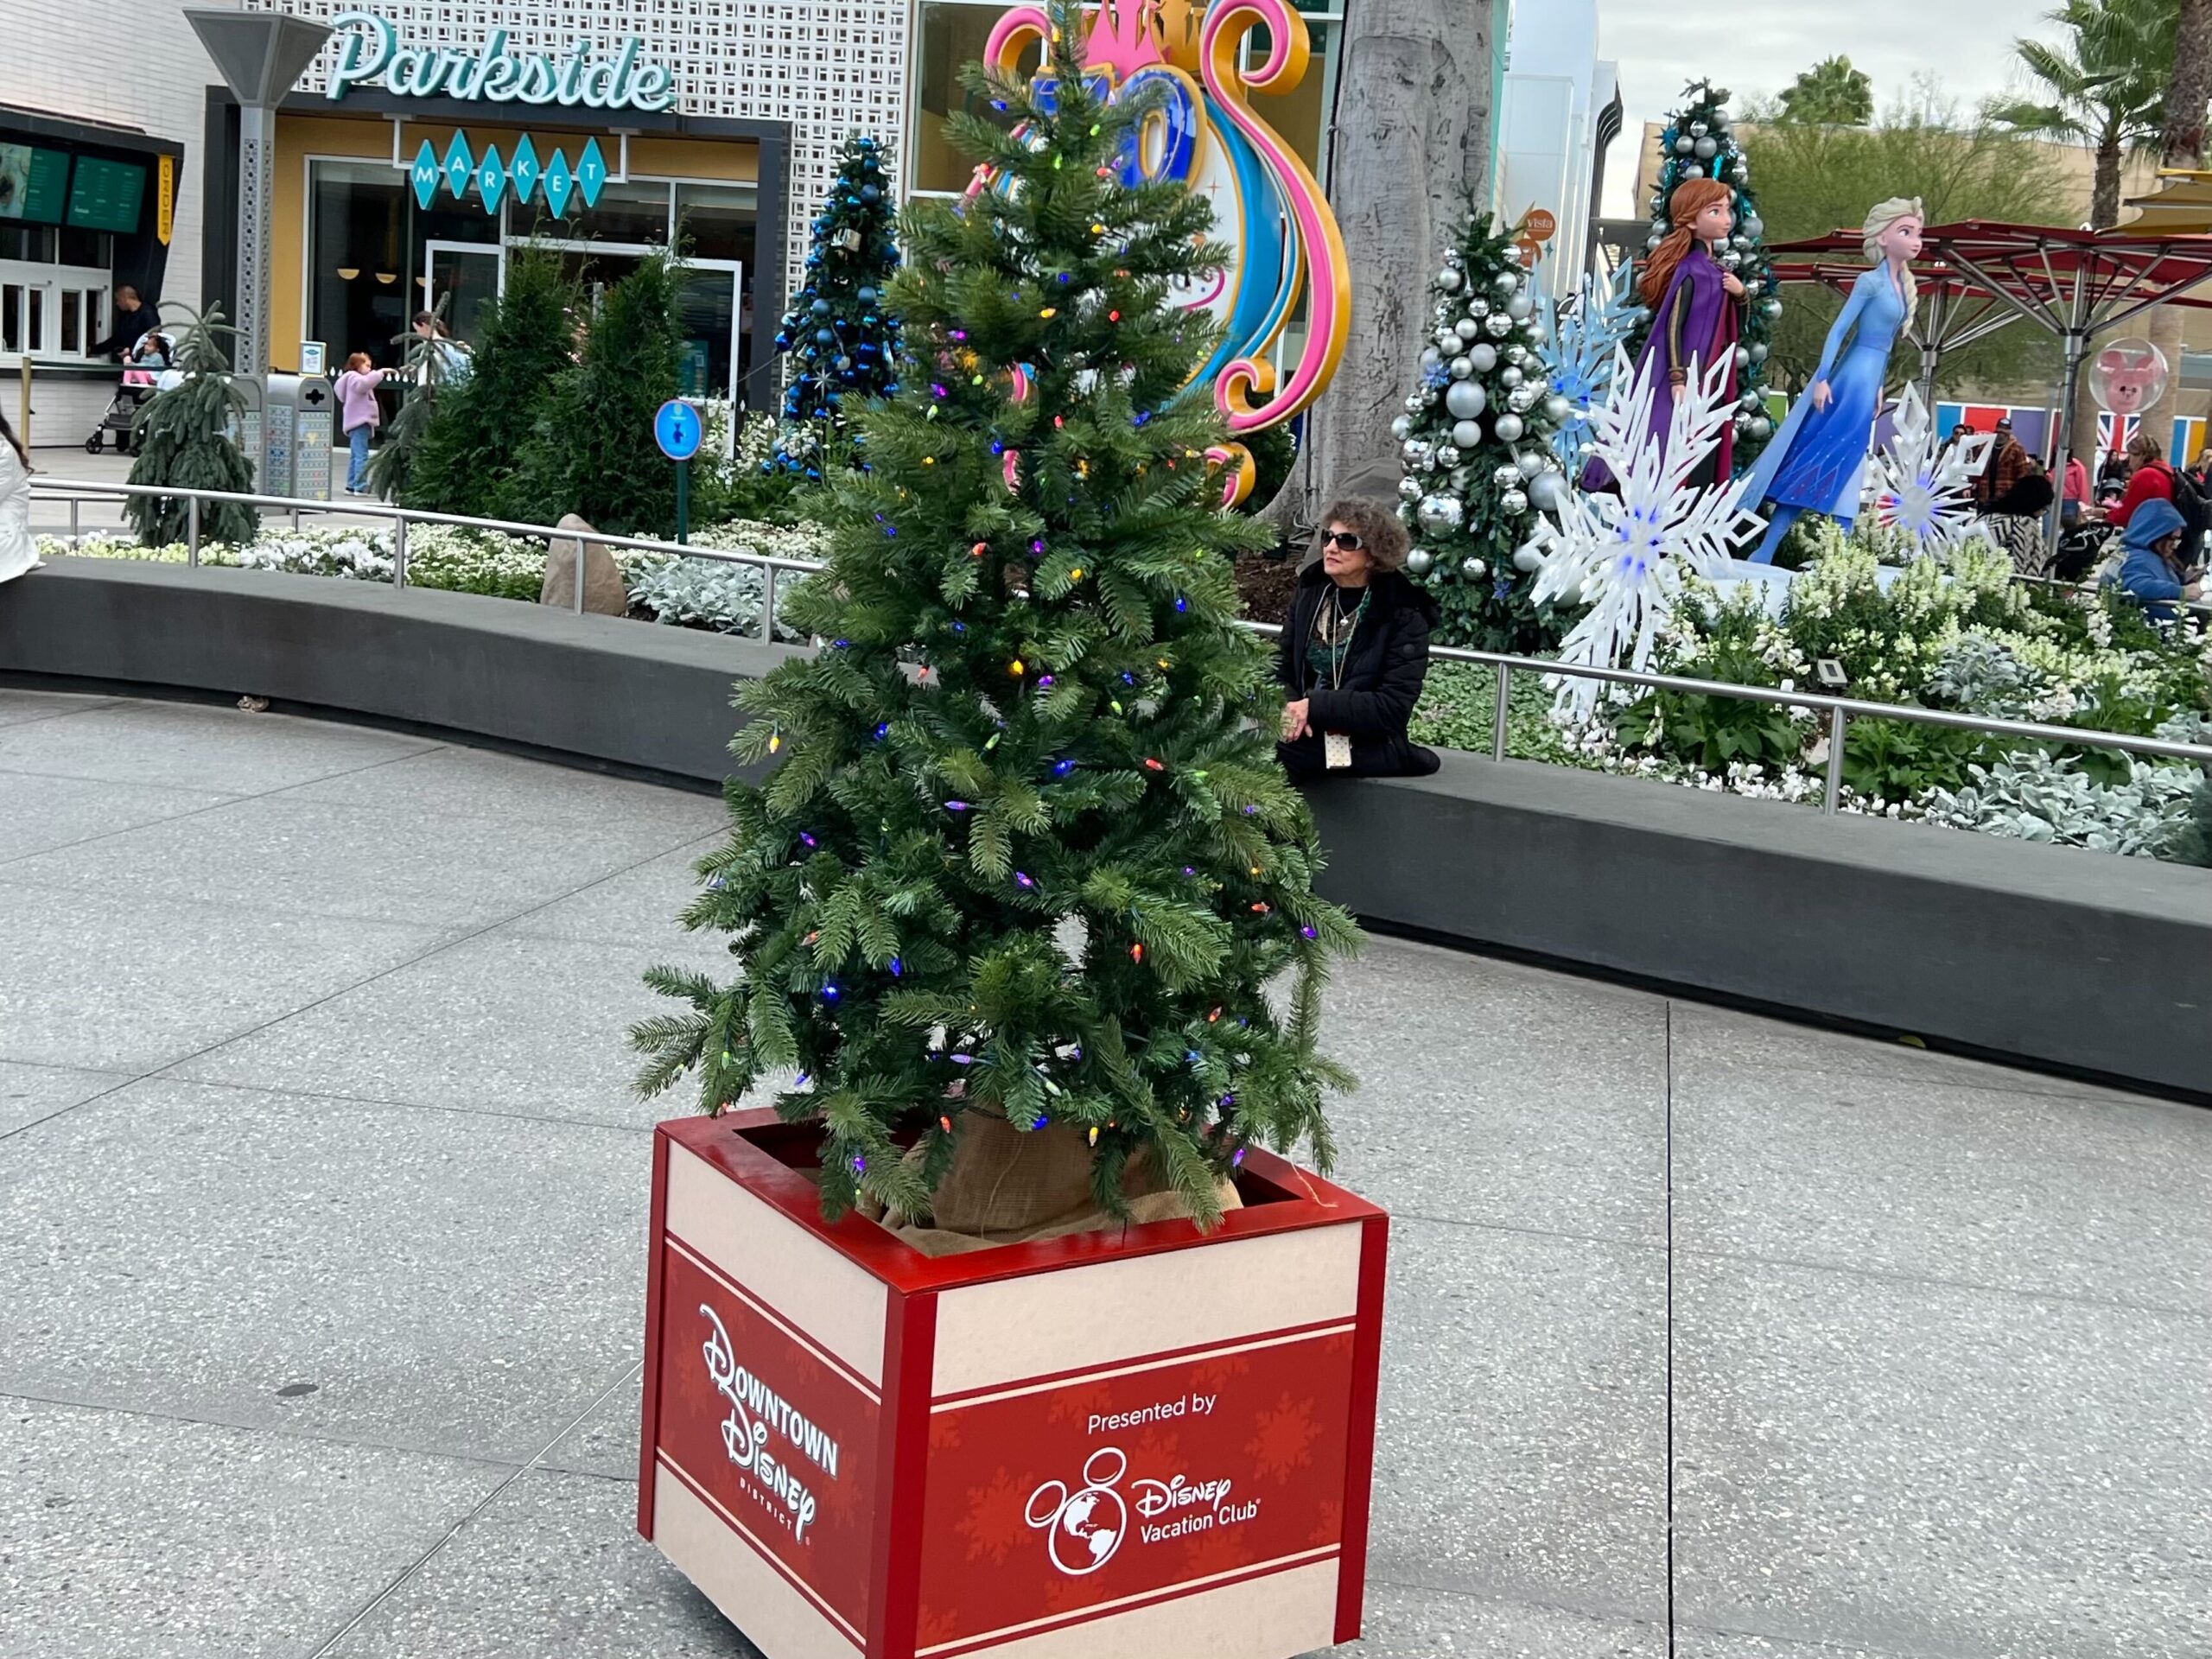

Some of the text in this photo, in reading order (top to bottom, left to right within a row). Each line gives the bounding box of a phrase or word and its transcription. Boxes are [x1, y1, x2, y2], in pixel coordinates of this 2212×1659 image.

[325, 10, 676, 112] Parkside
[416, 156, 596, 193] MARKET
[162, 163, 171, 236] ORDER
[1088, 1393, 1217, 1435] Presented by
[740, 1477, 792, 1531] DISTRICT
[1141, 1514, 1213, 1544] Vacation
